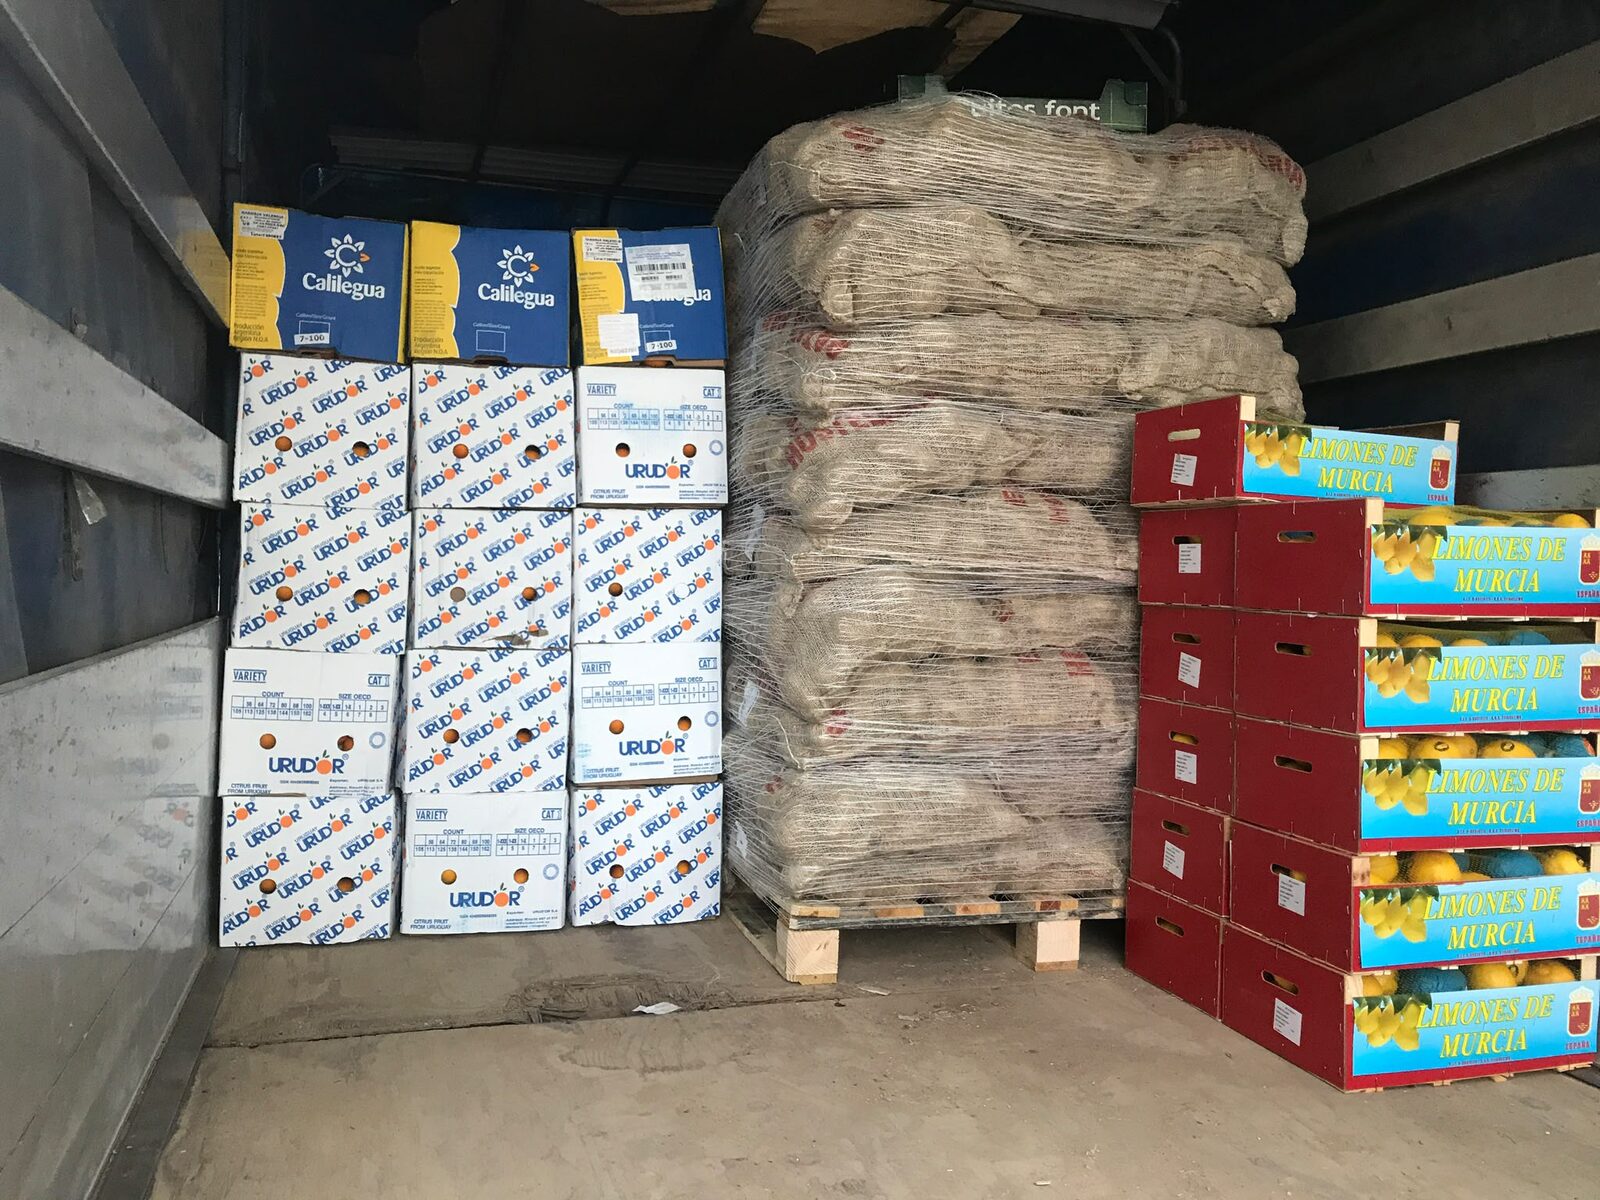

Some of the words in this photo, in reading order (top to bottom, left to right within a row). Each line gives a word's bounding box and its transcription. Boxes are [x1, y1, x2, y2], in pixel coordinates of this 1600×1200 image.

[1045, 100, 1100, 120] font
[302, 272, 385, 300] Calilegua
[478, 283, 554, 309] Calilegua
[587, 385, 616, 395] VARIETY
[703, 388, 714, 397] CAT
[1297, 435, 1387, 464] LIMONES
[1390, 445, 1418, 467] DE
[1318, 467, 1393, 493] MURCIA
[1432, 535, 1532, 561] LIMONES
[1536, 538, 1567, 561] DE
[1454, 568, 1541, 592] MURCIA
[233, 670, 267, 681] VARIETY
[582, 663, 611, 673] VARIETY
[699, 660, 711, 669] CAT
[1427, 656, 1530, 681] LIMONES
[1534, 655, 1566, 679] DE
[368, 676, 382, 685] CAT
[1450, 687, 1538, 713] MURCIA
[1425, 768, 1530, 794] LIMONES
[1534, 768, 1566, 792] DE
[416, 810, 448, 820] VARIETY
[542, 810, 555, 819] CAT
[1448, 800, 1537, 825] MURCIA
[1423, 889, 1527, 920] LIMONES
[1531, 886, 1563, 911] DE
[1447, 920, 1536, 950] MURCIA
[1416, 997, 1520, 1029] LIMONES
[1523, 994, 1555, 1019] DE
[1439, 1028, 1527, 1058] MURCIA
